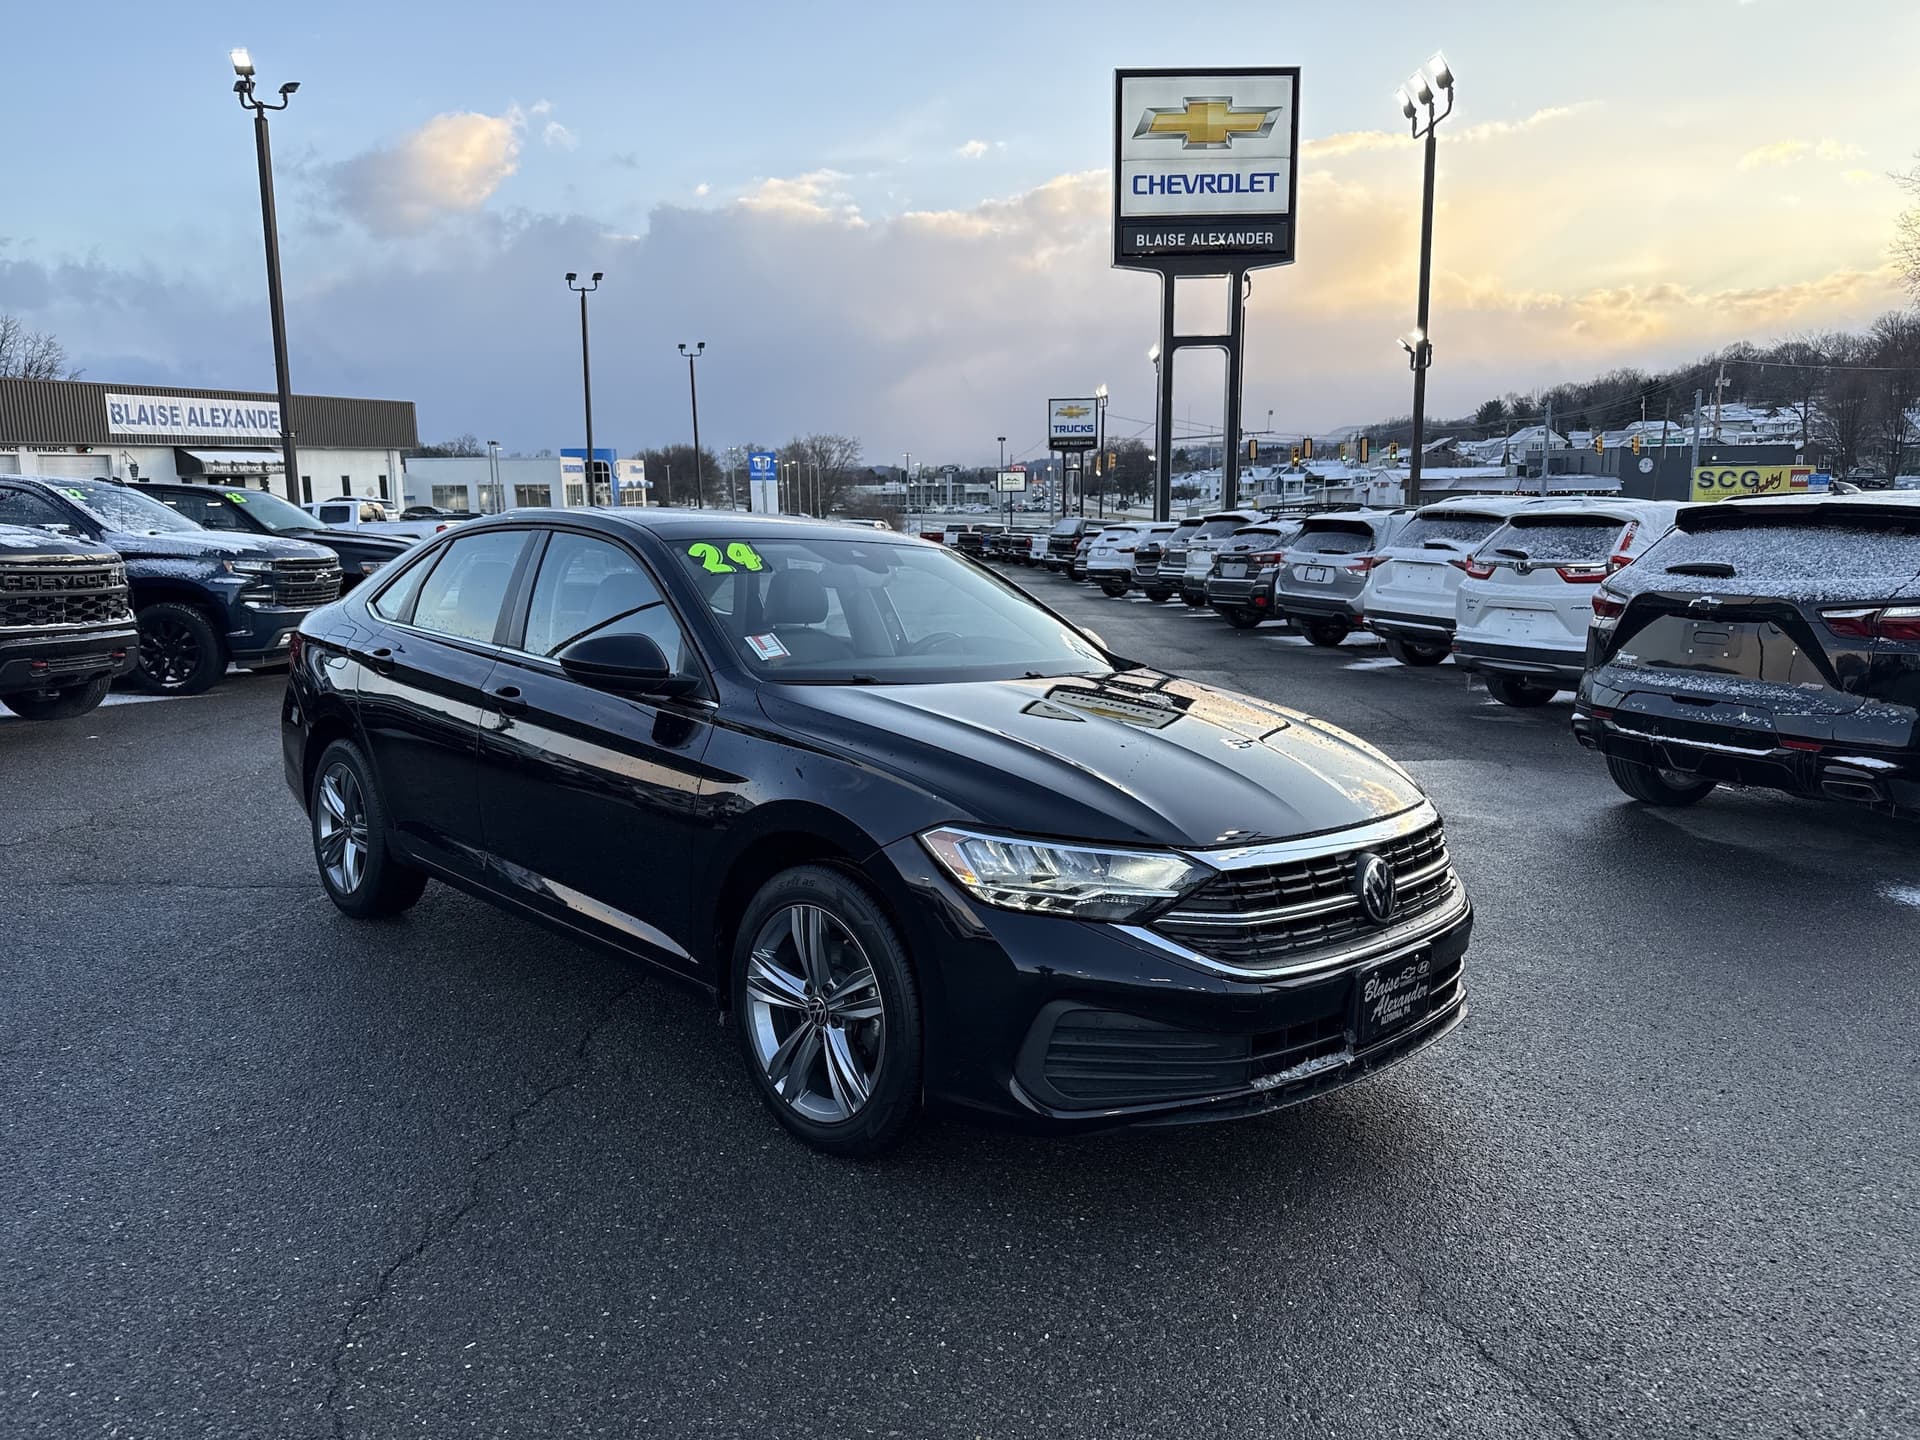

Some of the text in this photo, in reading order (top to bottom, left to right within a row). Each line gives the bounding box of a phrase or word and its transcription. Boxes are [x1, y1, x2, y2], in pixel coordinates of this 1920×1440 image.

[1132, 173, 1280, 195] CHEVROLET
[1136, 232, 1274, 247] BLAISE ALEXANDER
[110, 402, 280, 430] BLAISE ALEXANDE
[1053, 424, 1094, 433] TRUCKS
[1697, 470, 1761, 489] SCG
[688, 542, 763, 574] 24
[1364, 977, 1400, 1003] Blaise
[1370, 982, 1429, 1022] Alexander
